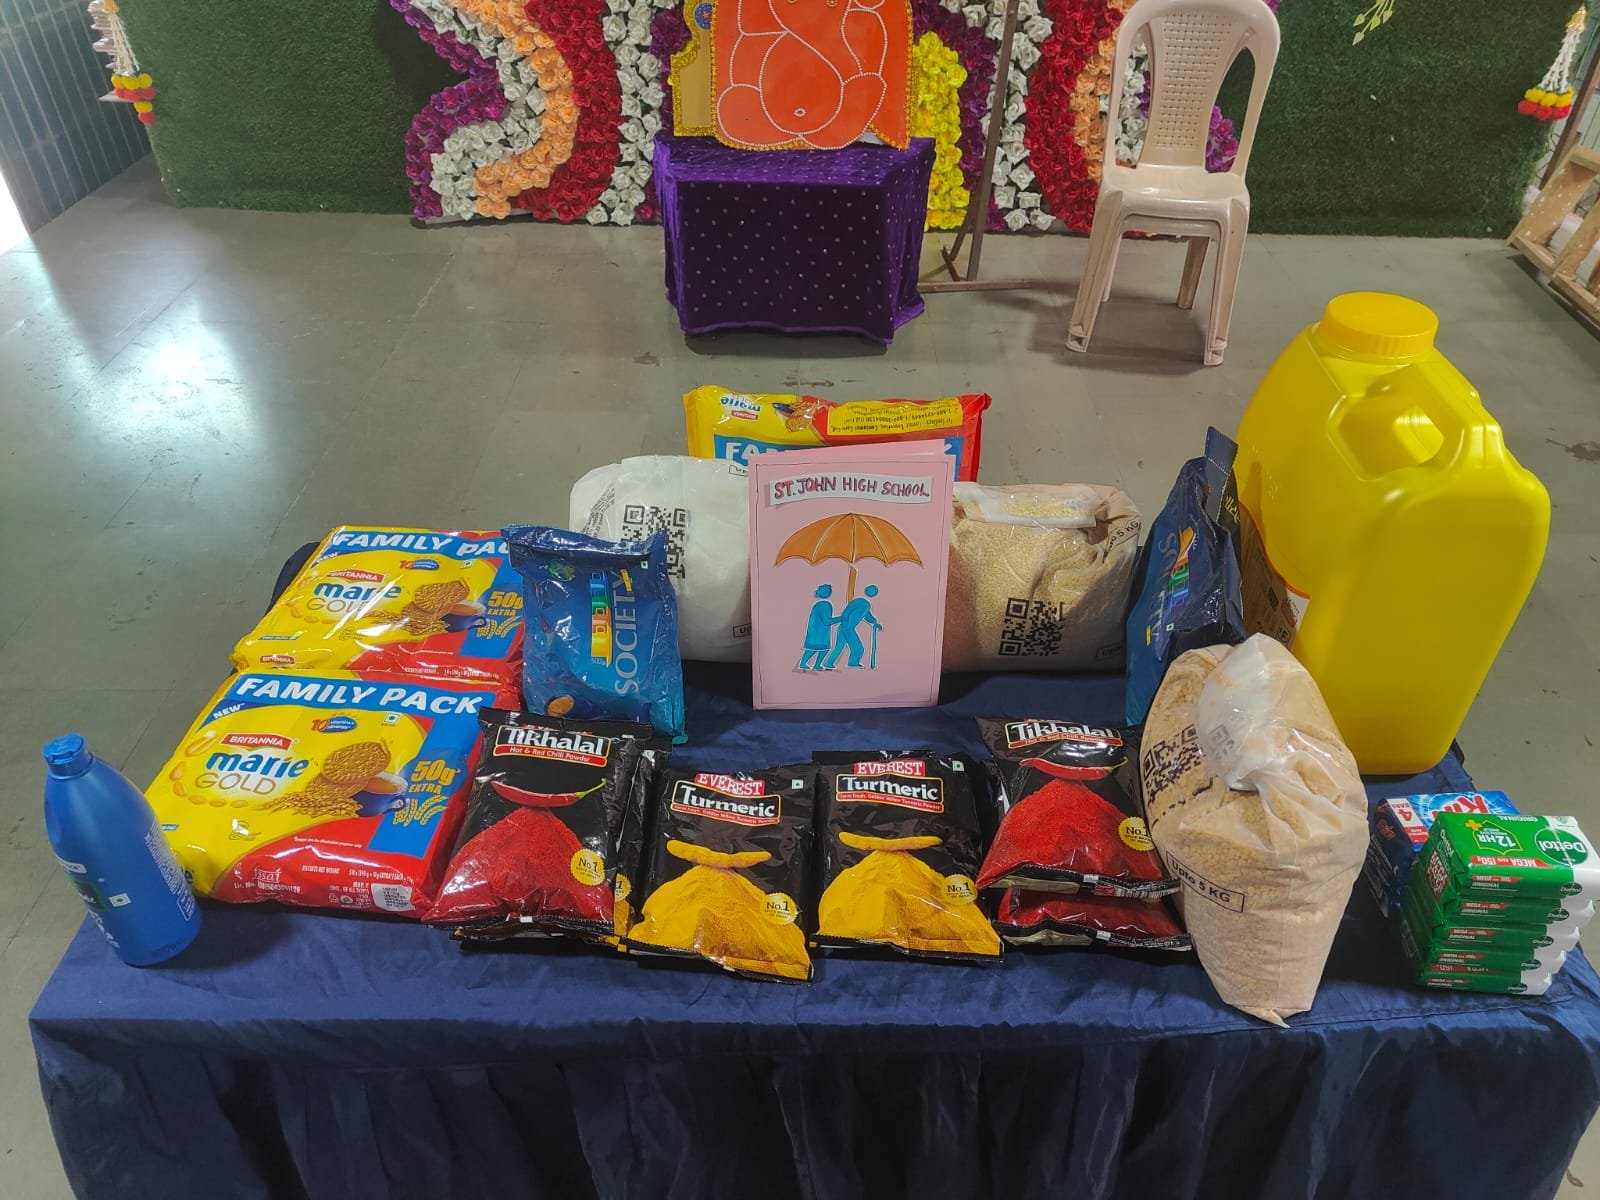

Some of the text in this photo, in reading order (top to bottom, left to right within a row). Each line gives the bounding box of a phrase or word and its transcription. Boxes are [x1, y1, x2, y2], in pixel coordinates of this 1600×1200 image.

[842, 477, 878, 493] HIGH
[881, 481, 930, 497] SCHOOL
[333, 534, 510, 556] FAMILY PAC
[314, 582, 402, 601] mare
[306, 597, 370, 613] GOL
[612, 570, 639, 695] SOCIETY
[235, 677, 485, 714] FAMILY PACK
[212, 704, 241, 719] NEW
[1011, 721, 1114, 741] Tikhalal
[229, 735, 283, 747] BRITANNIA
[205, 752, 310, 779] marie
[546, 750, 564, 758] Chilli
[565, 753, 591, 762] Powder
[857, 761, 923, 776] EVEREST
[195, 772, 277, 795] GOLD
[408, 783, 442, 794] EXTRA
[698, 773, 763, 796] EVEREST
[841, 776, 939, 801] Turmeric
[680, 785, 776, 818] Turmeric
[1398, 809, 1413, 821] 4
[1126, 826, 1149, 837] No.1
[1538, 840, 1587, 853] Dettol
[1511, 858, 1537, 867] MEGA
[1171, 860, 1231, 902] Upto 5 KG
